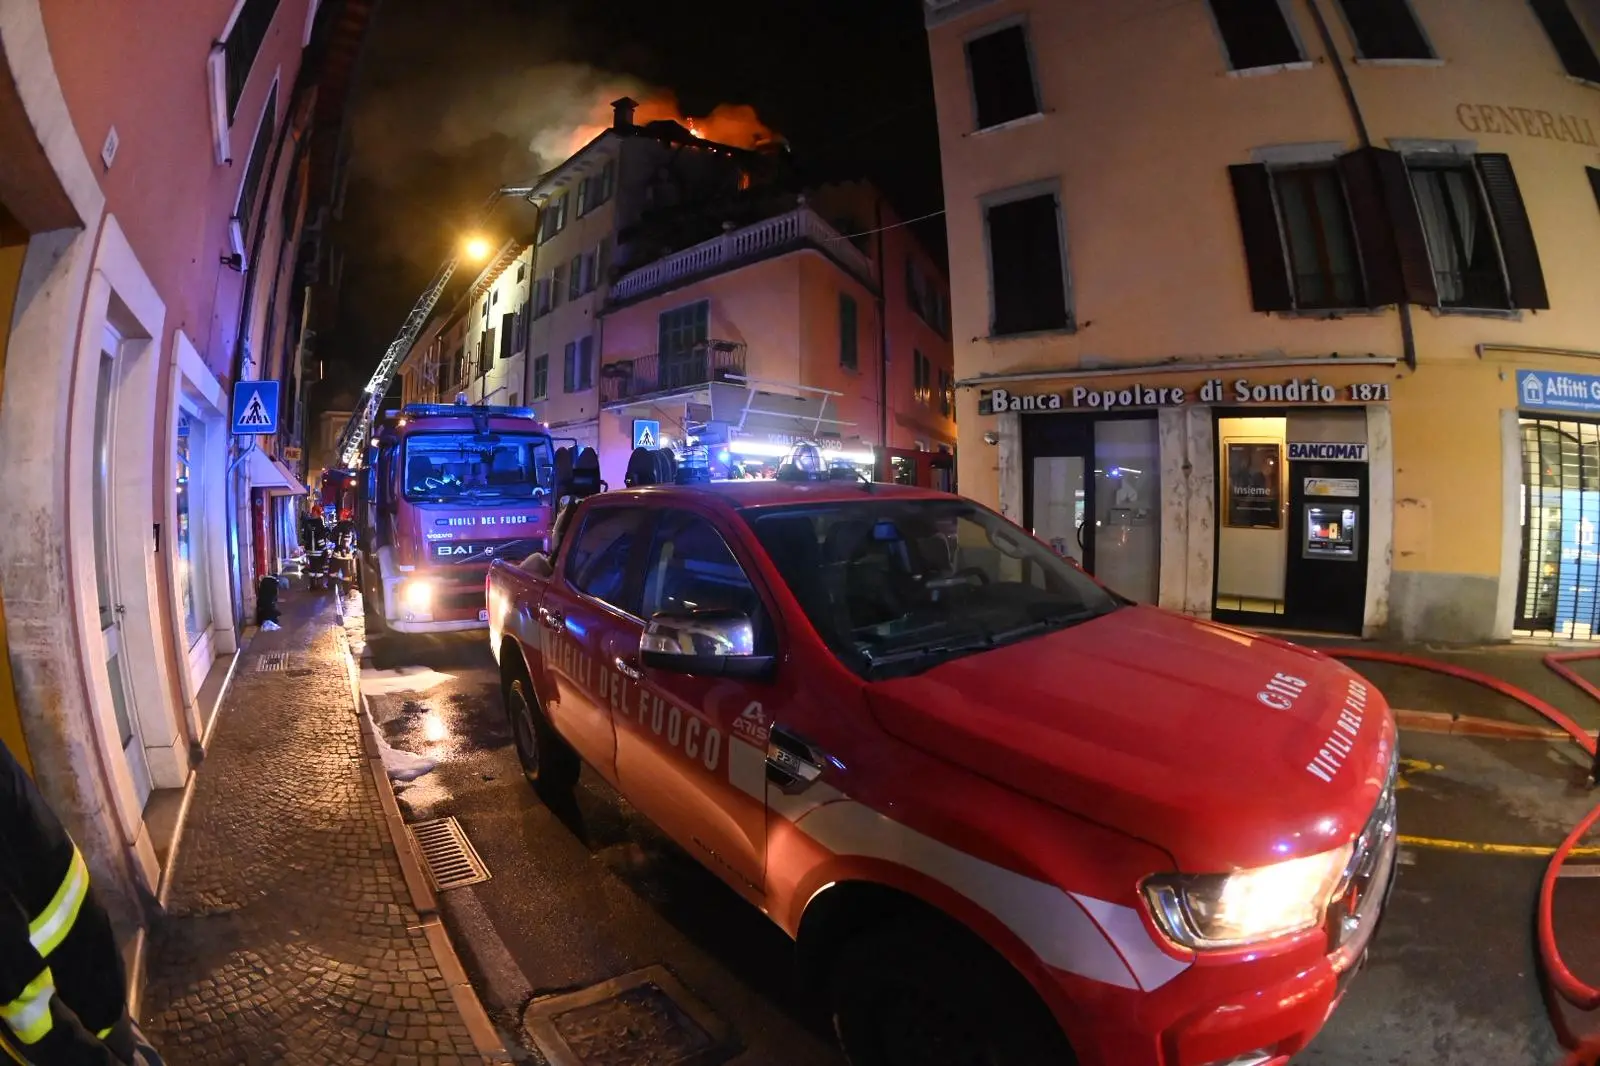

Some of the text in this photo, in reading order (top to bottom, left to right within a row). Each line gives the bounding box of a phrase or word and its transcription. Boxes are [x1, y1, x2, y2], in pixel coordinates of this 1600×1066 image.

[1456, 103, 1599, 147] GENERALI
[992, 378, 1391, 413] Banca Popolare di Sondrio 1871
[1546, 377, 1588, 399] Affitti
[1289, 444, 1365, 459] BANCOMAT
[448, 515, 527, 526] VIGILI DEL FUOCO
[437, 546, 473, 556] BAI
[550, 634, 721, 771] VIGILI DEL FUOCO
[1337, 709, 1364, 736] DEL
